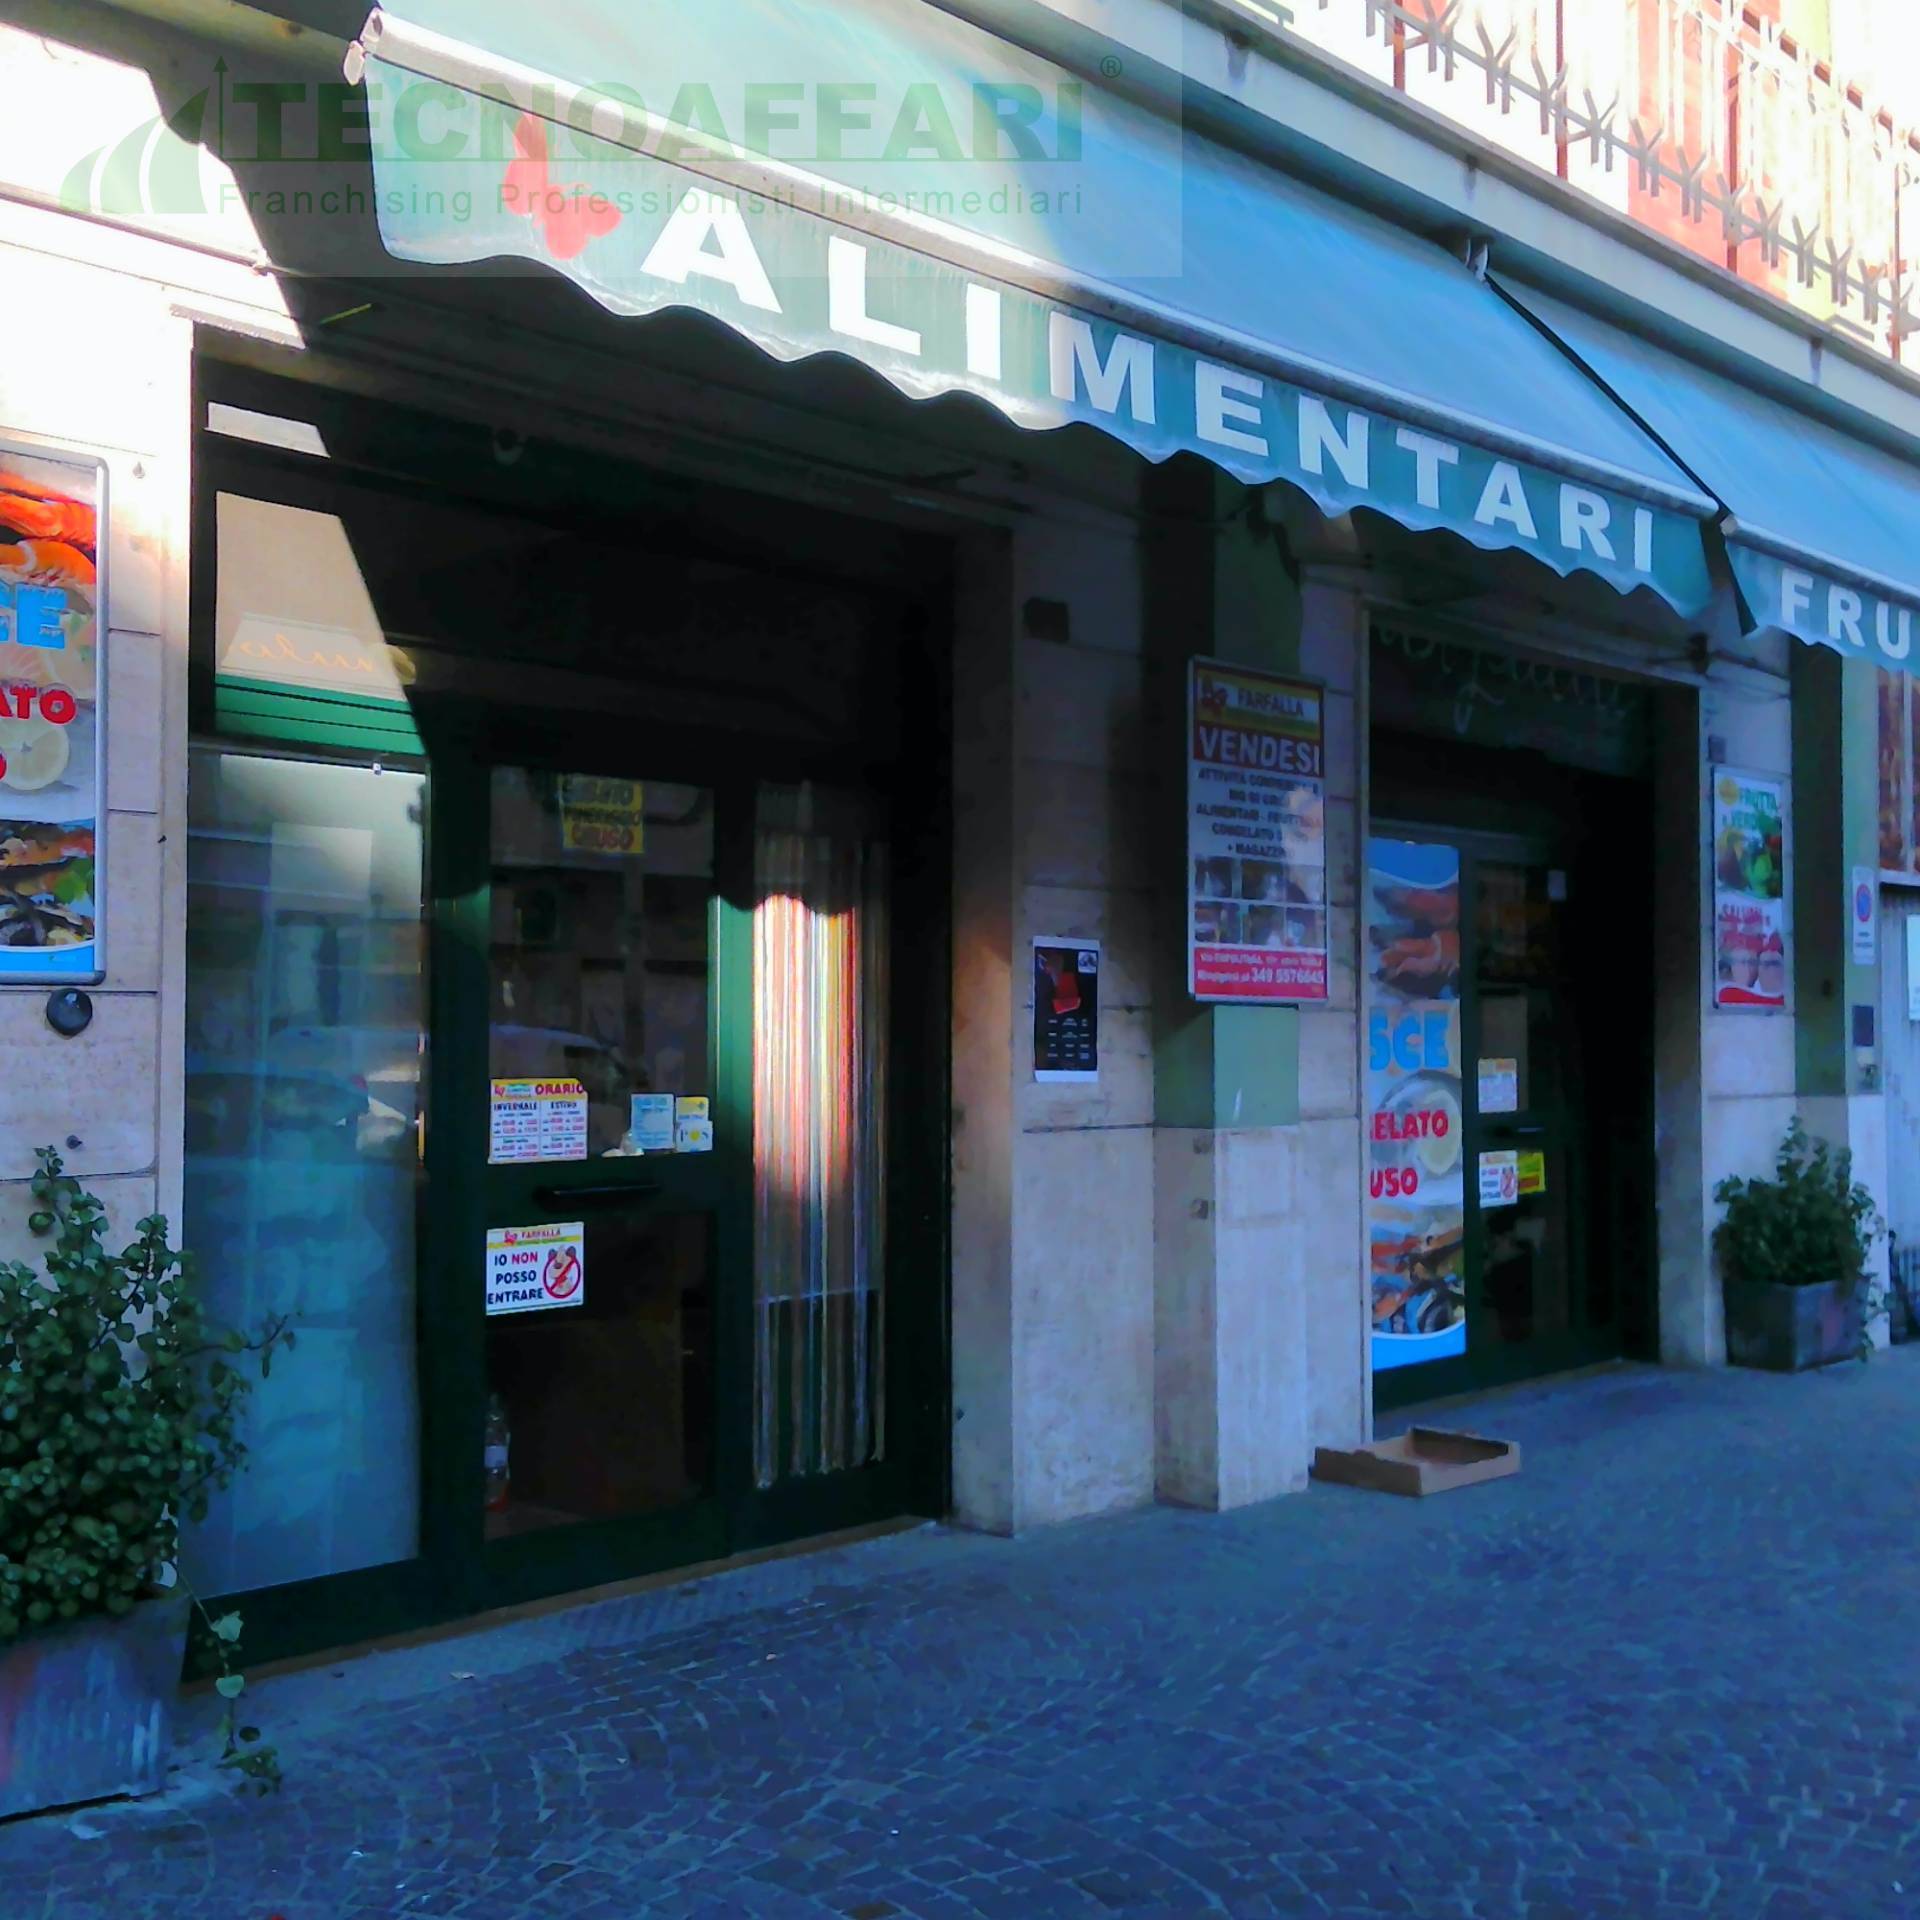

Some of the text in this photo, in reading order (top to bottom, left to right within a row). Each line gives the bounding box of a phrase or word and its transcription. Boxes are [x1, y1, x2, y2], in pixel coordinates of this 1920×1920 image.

[641, 187, 1652, 572] ALIMENTARI
[0, 580, 67, 650] E
[1780, 568, 1910, 659] FRU
[1200, 726, 1320, 776] VENDESI
[535, 1083, 584, 1095] ORARIO
[494, 1101, 537, 1112] INVERNALE
[1370, 1108, 1449, 1142] ELATO
[494, 1251, 538, 1267] IO NON
[495, 1269, 537, 1286] POSSO
[487, 1287, 544, 1305] ENTRARE
